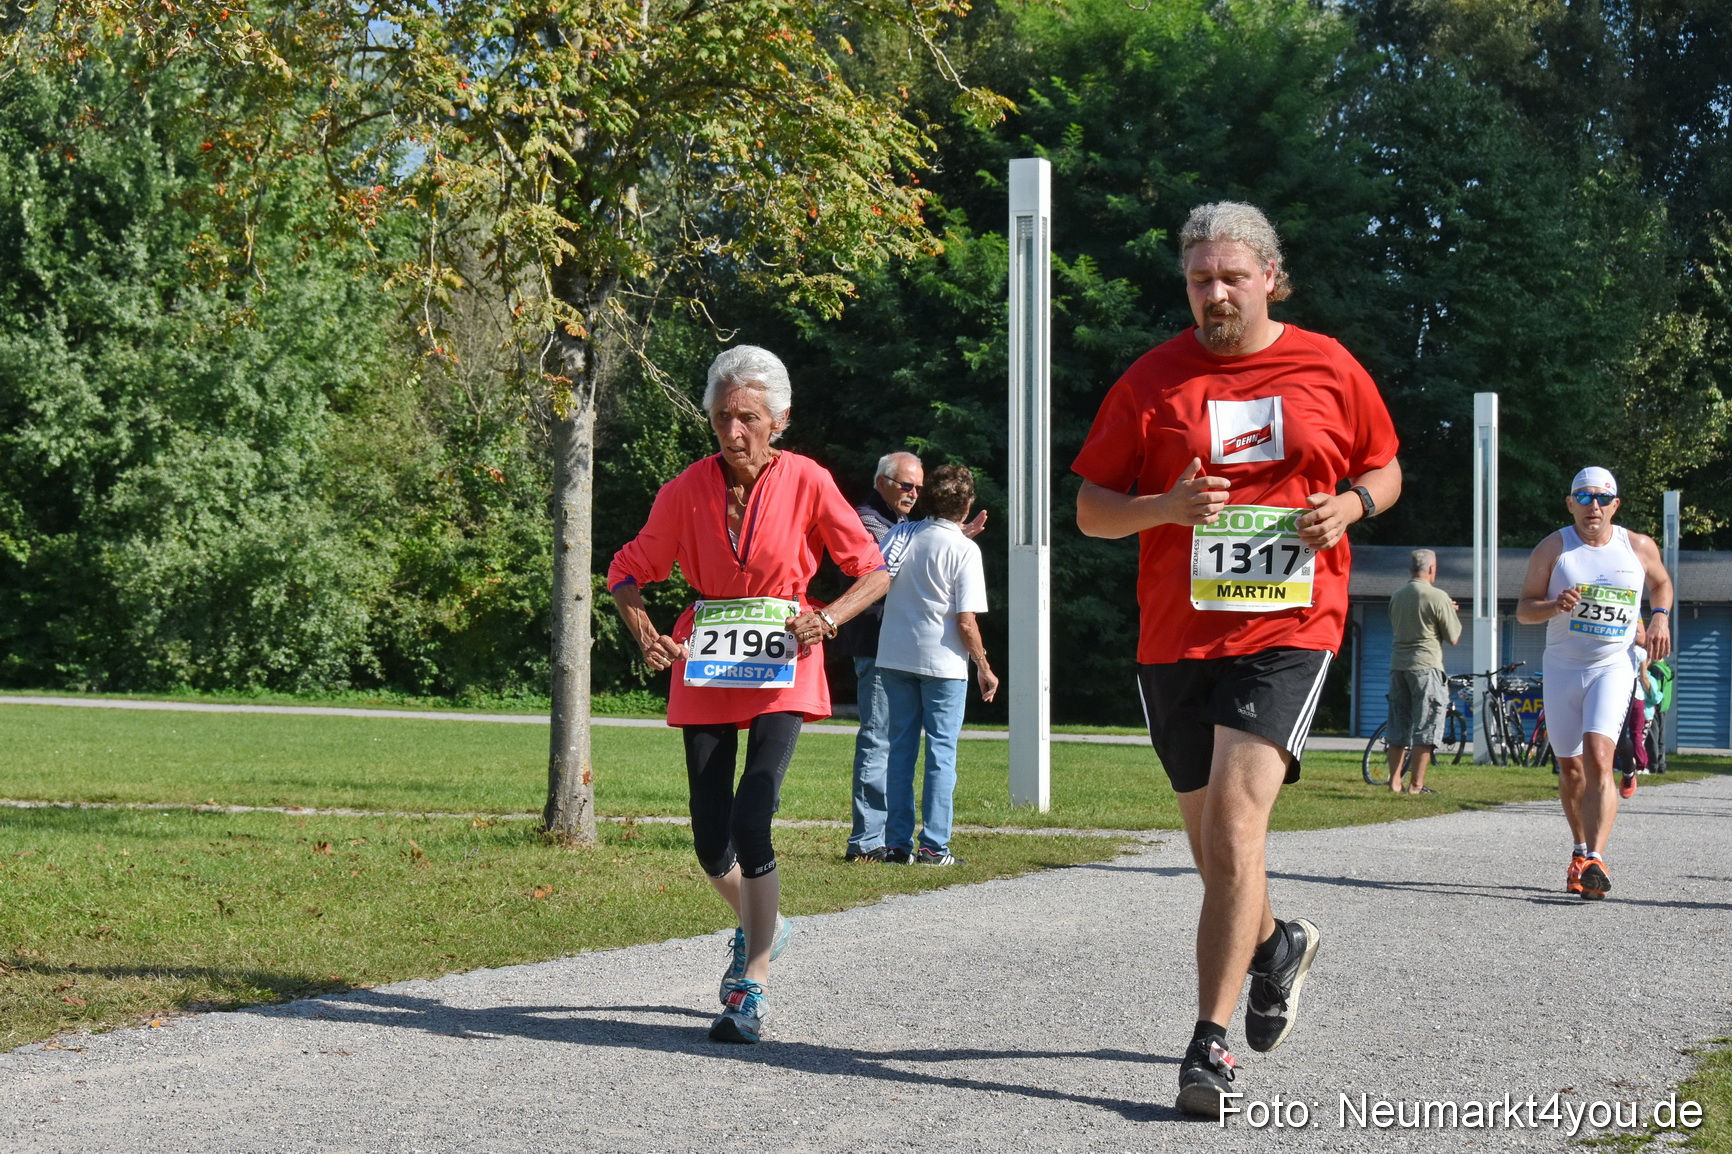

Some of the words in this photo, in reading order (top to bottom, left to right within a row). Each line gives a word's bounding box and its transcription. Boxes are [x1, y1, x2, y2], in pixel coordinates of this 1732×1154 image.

[1236, 434, 1259, 448] DEHN
[1203, 511, 1301, 533] BOCK
[1208, 542, 1300, 576] 1317
[1217, 584, 1286, 599] MARTIN
[1581, 586, 1630, 603] BOCK
[703, 604, 787, 623] BOCK
[1577, 602, 1628, 624] 2354
[1582, 624, 1618, 635] STEFAN
[700, 629, 786, 659] 2196
[703, 664, 776, 679] CHRISTA
[1238, 708, 1257, 719] adidas
